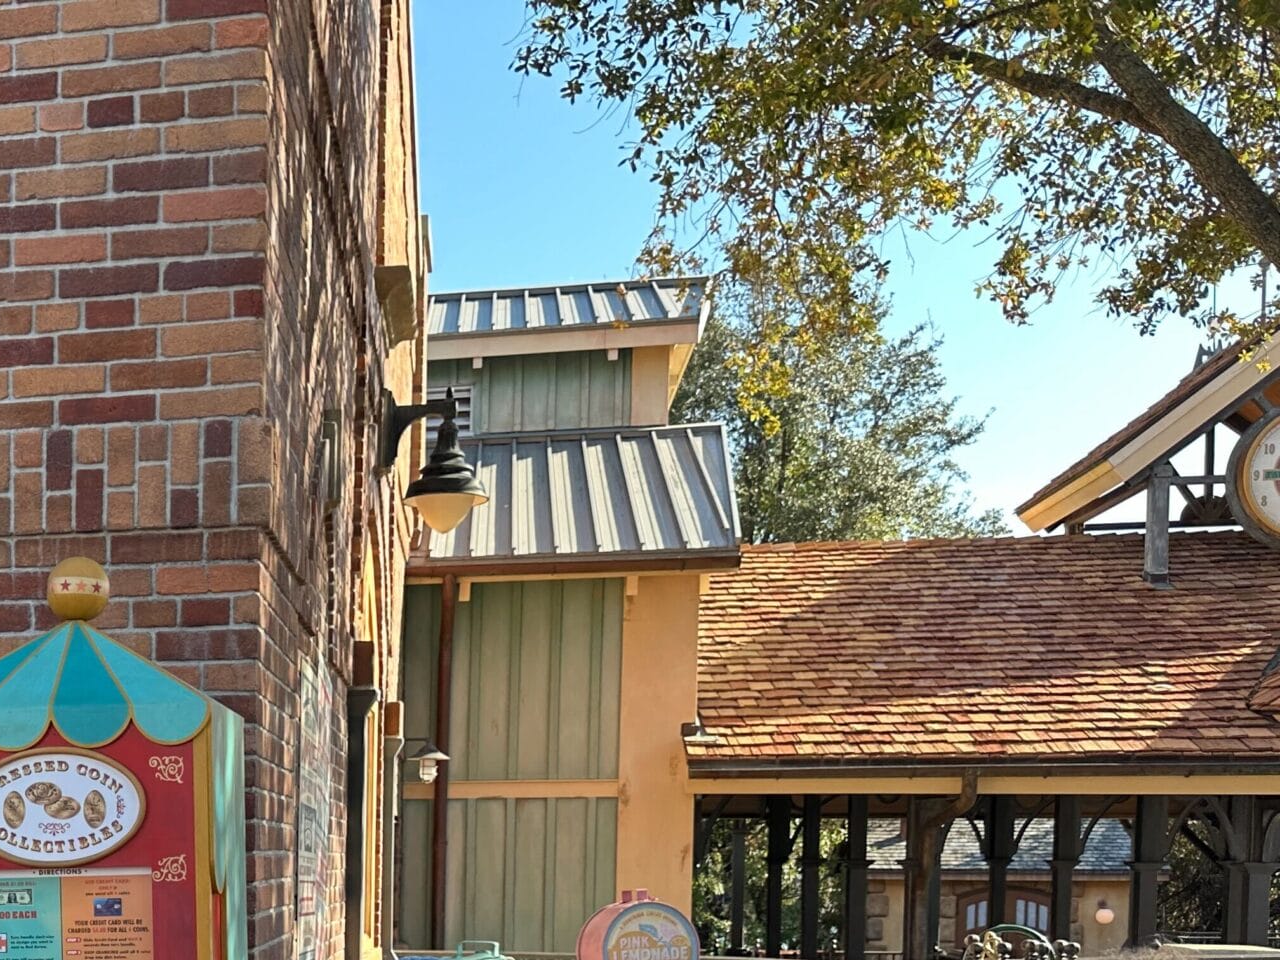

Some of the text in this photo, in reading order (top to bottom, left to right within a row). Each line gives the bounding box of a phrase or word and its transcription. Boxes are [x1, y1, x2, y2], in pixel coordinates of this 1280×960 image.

[1263, 443, 1275, 455] 10
[1253, 470, 1260, 481] 9
[1261, 495, 1268, 507] 8
[76, 763, 124, 795] COIN
[38, 868, 82, 876] DIRECTIONS
[11, 911, 37, 919] EACH
[620, 936, 650, 949] PINK
